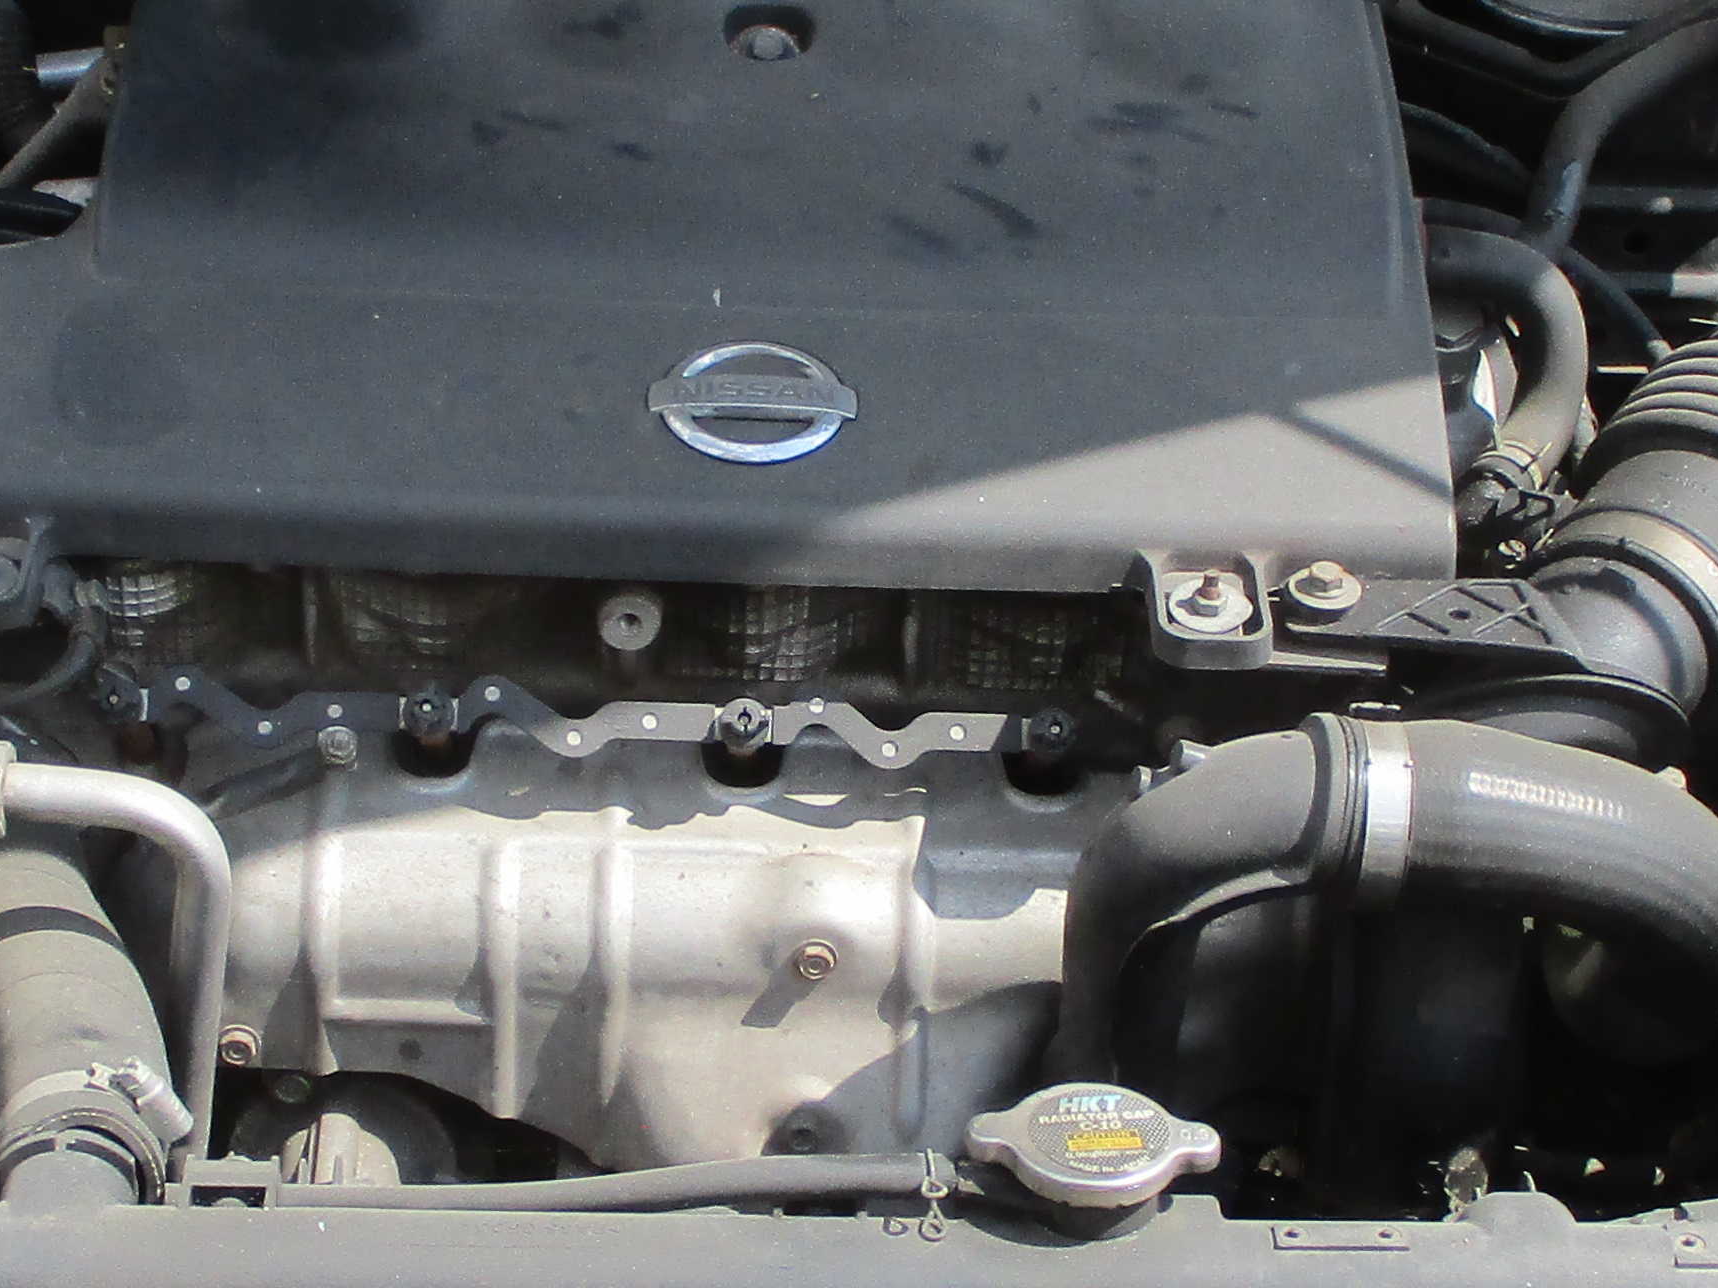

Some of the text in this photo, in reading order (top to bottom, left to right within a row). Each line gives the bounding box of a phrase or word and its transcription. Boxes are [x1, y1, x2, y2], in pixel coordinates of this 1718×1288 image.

[674, 379, 836, 402] NISSAN
[1058, 1094, 1123, 1114] HKT
[1039, 1109, 1156, 1125] RADIATOR CAP
[1079, 1120, 1123, 1130] C-10
[1069, 1159, 1100, 1174] MADE
